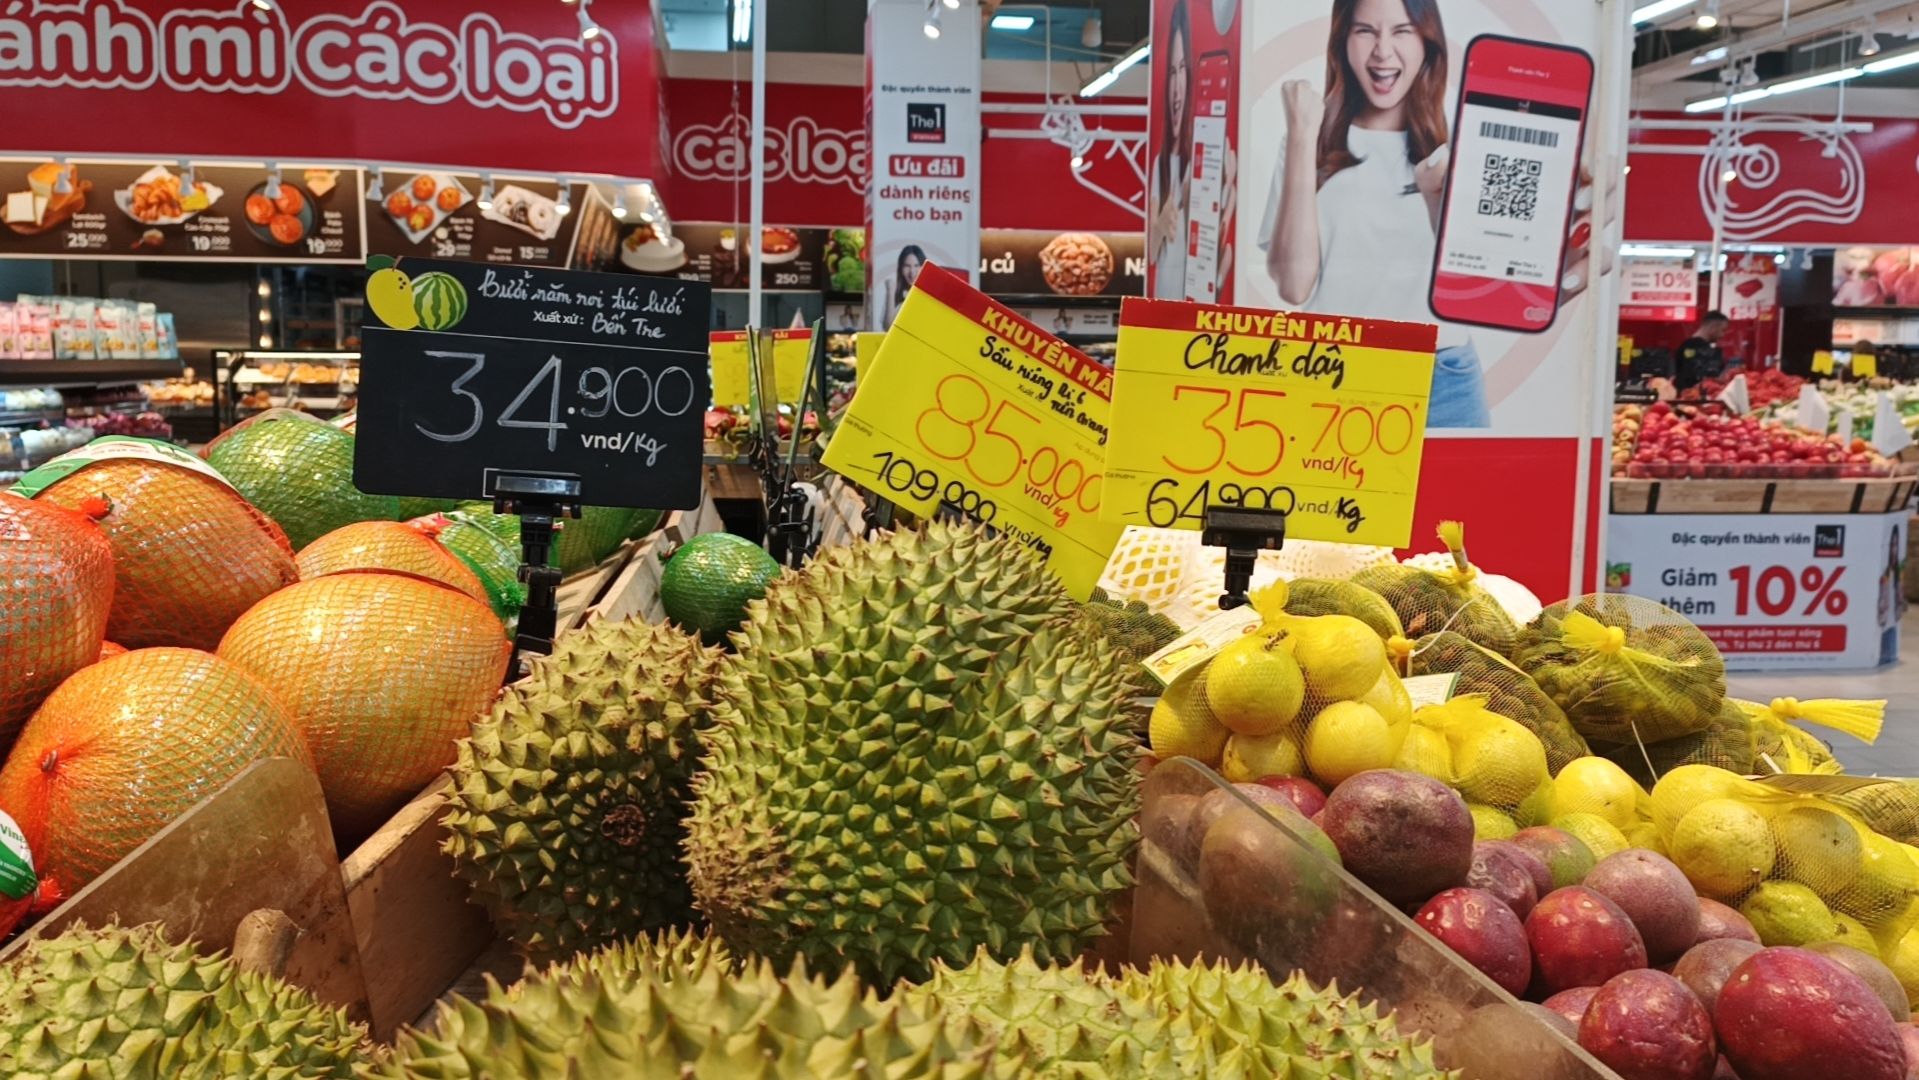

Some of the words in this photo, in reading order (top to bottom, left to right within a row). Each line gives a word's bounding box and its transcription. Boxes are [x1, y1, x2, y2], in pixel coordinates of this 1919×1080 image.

[174, 10, 277, 79] mì
[305, 16, 448, 89] các
[473, 26, 607, 116] loại
[893, 156, 923, 175] Ưu
[926, 157, 959, 176] đãi
[879, 185, 924, 200] dành
[893, 206, 925, 220] cho
[929, 206, 963, 225] bạn
[990, 251, 1016, 274] củ
[611, 287, 640, 311] túi
[533, 310, 562, 324] Xuất
[591, 312, 628, 336] Bến
[631, 317, 667, 339] Tre
[981, 306, 1078, 374] KHUYẾN
[1195, 310, 1307, 339] KHUYẾN
[1312, 318, 1363, 344] MÃI
[1183, 333, 1284, 376] Chanh
[414, 350, 696, 452] 34.900
[1161, 384, 1414, 478] 35.700
[1671, 532, 1696, 546] Đặc
[1743, 532, 1780, 544] thành
[1783, 532, 1811, 545] viên
[1661, 566, 1718, 587] Giảm
[1728, 564, 1849, 617] 10%
